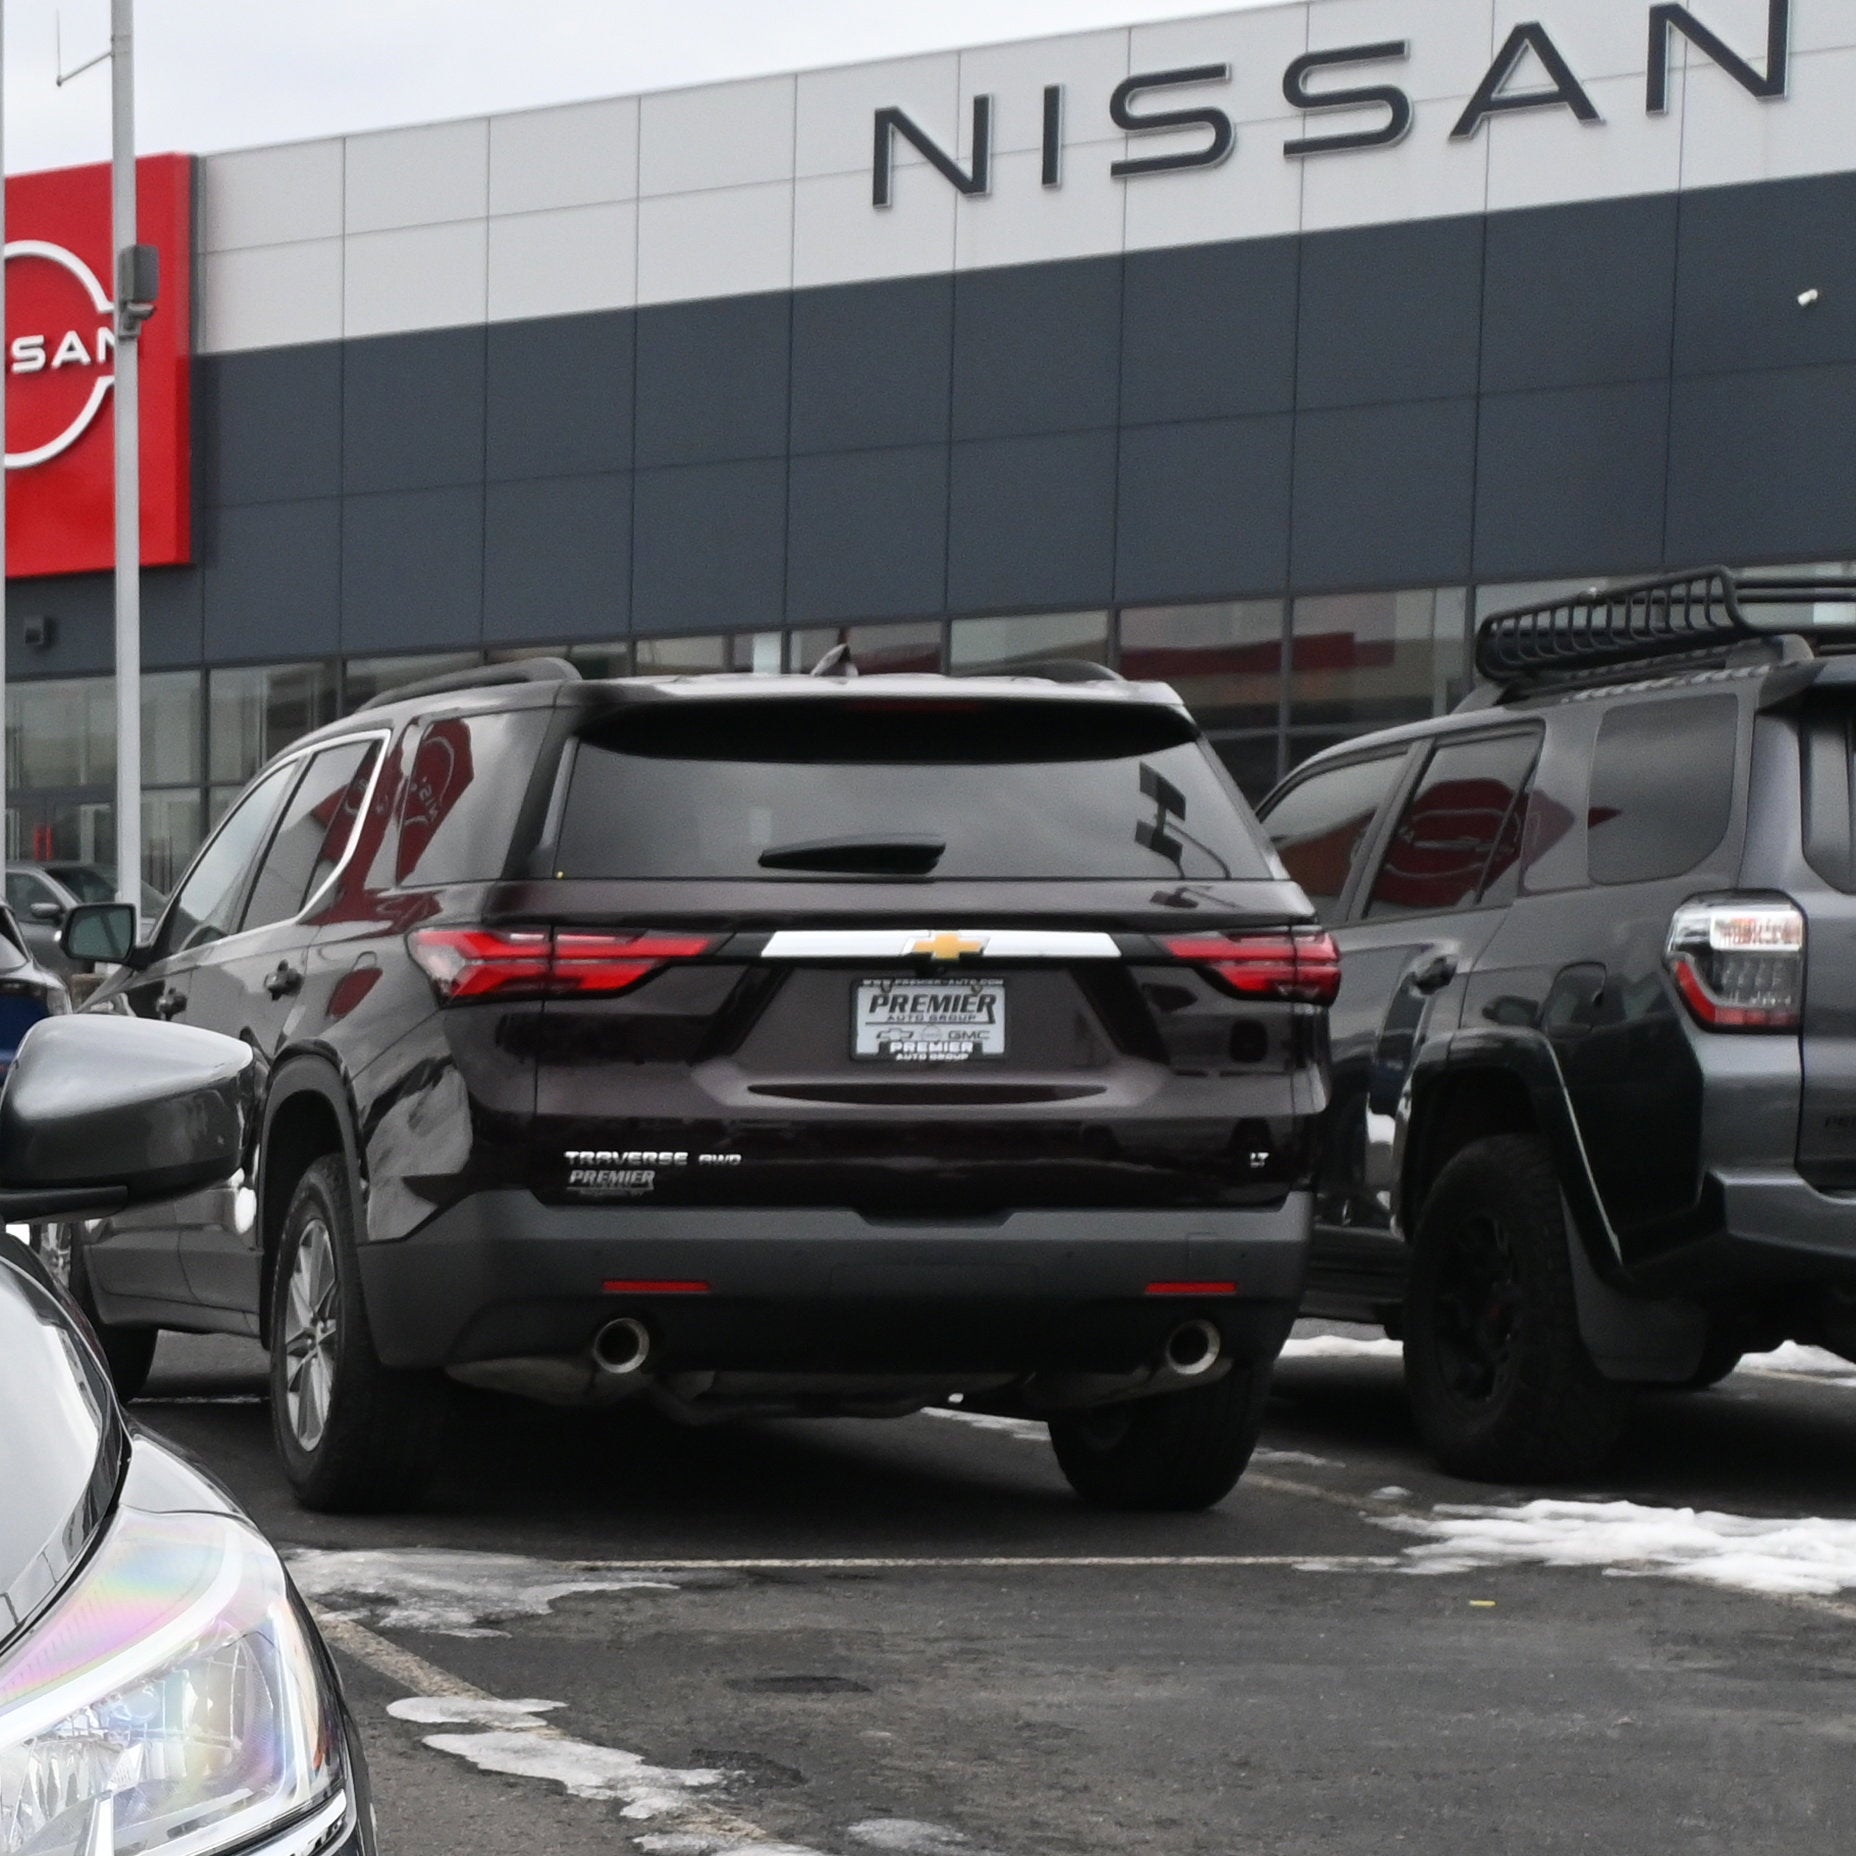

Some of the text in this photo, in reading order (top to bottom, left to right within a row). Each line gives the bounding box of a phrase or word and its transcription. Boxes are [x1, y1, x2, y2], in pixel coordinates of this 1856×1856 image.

[872, 0, 1789, 209] NISSAN
[869, 994, 996, 1025] PREMIER
[948, 1030, 991, 1040] GMC
[890, 1042, 974, 1054] PREMIER
[896, 1053, 969, 1061] AUTO GROUP
[565, 1151, 741, 1165] TRAVERSE AWD
[568, 1170, 655, 1189] PREMIER
